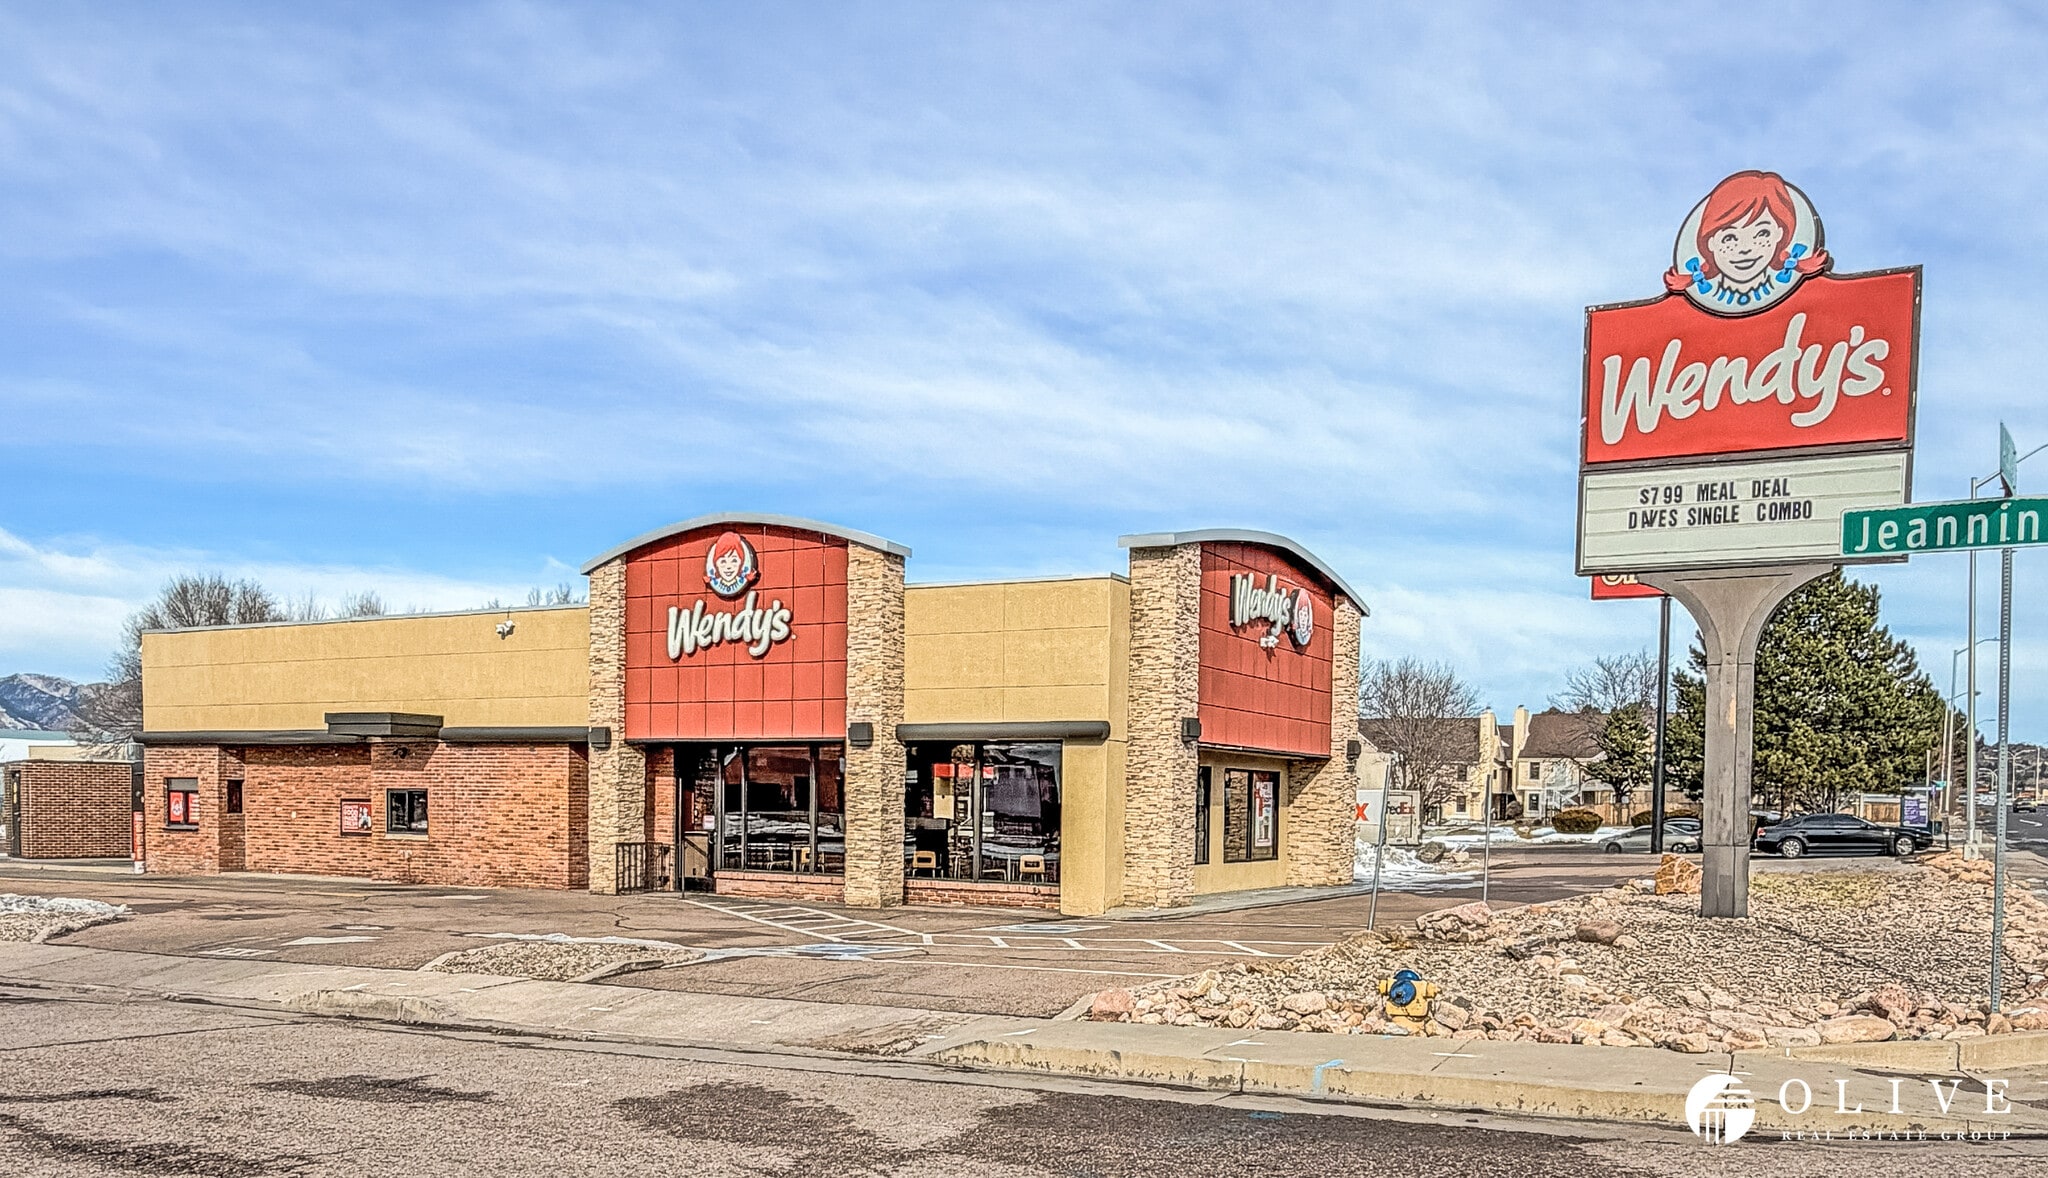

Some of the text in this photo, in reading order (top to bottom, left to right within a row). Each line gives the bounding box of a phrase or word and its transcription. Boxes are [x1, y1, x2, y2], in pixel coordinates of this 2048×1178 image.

[1602, 313, 1889, 445] Wendy's
[1628, 500, 1813, 530] DAVES SINGLE COMBO
[1697, 482, 1738, 502] MEAL
[1752, 478, 1791, 498] DEAL
[1854, 502, 2039, 552] Jeannin
[667, 590, 792, 660] Wendy's
[1234, 572, 1292, 637] Wendy's
